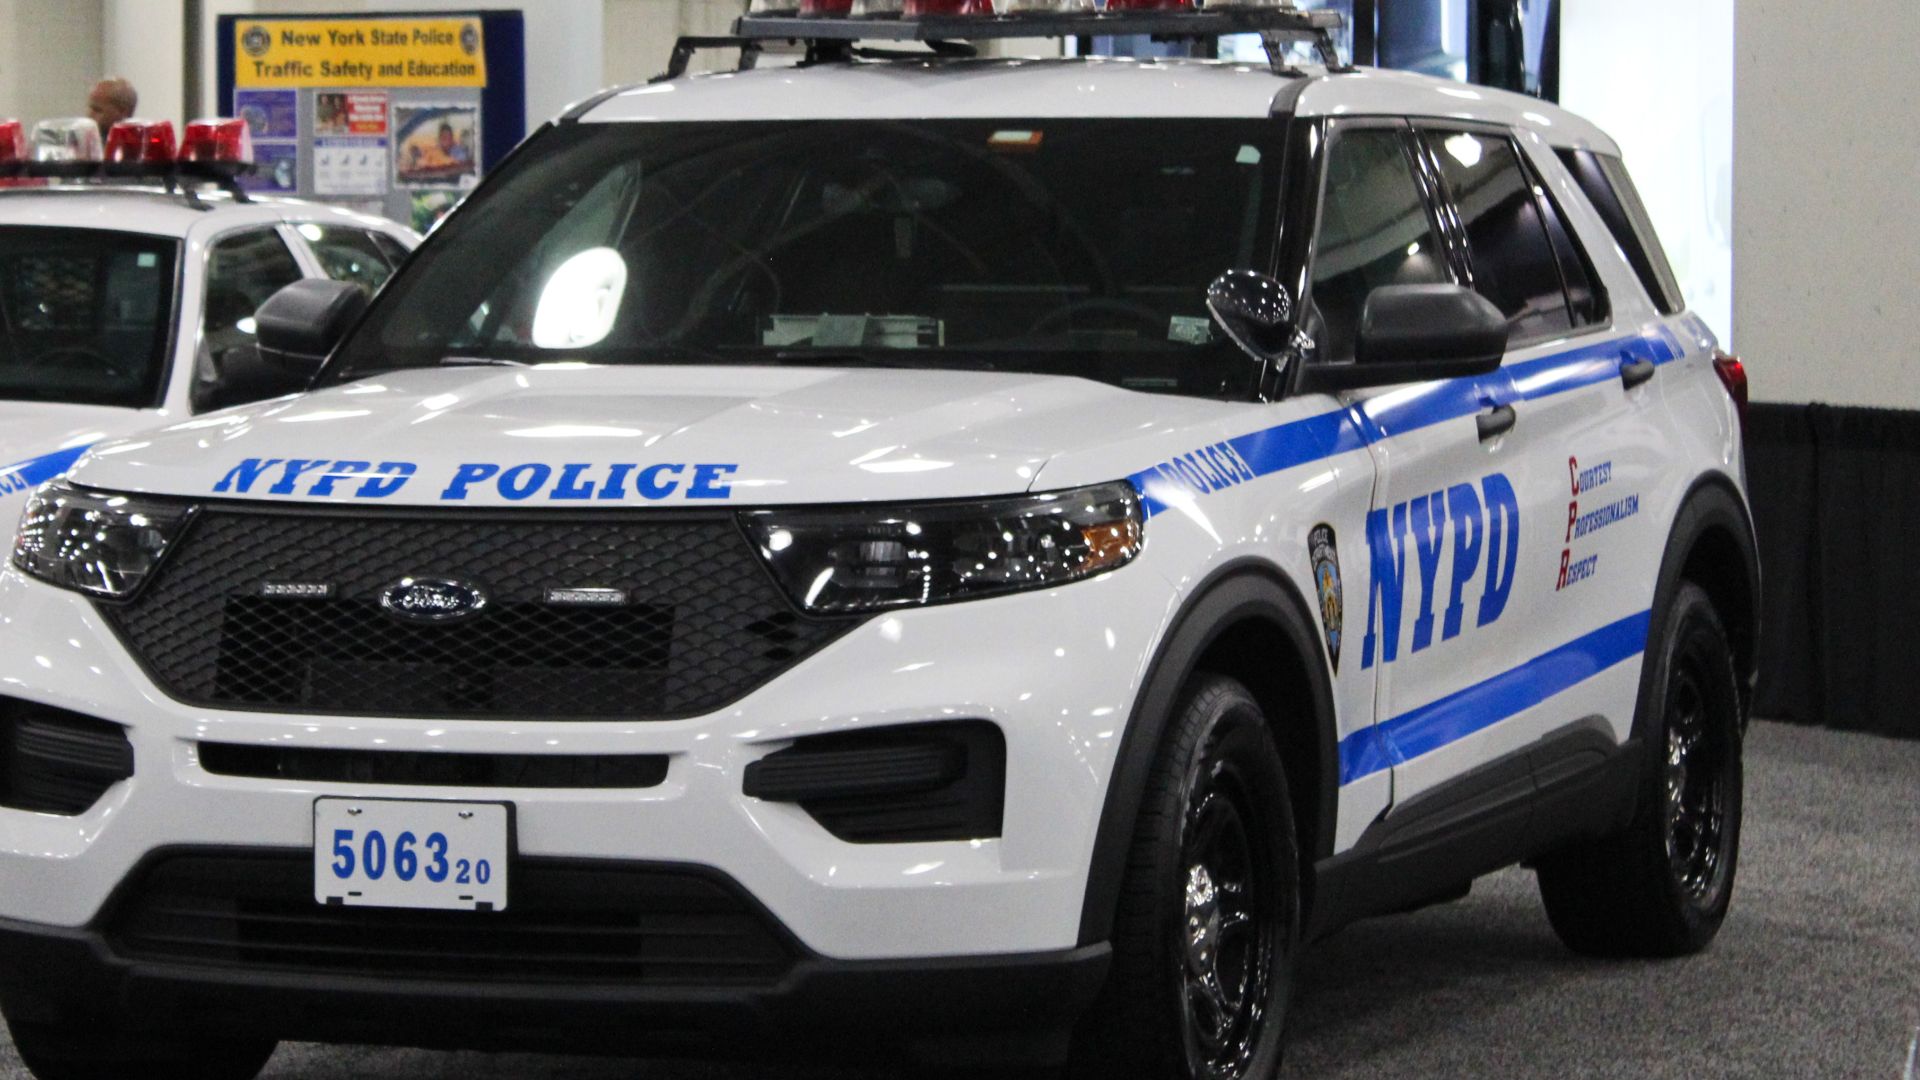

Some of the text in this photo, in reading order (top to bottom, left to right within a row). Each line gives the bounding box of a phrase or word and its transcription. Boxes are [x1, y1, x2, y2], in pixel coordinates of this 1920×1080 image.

[281, 27, 454, 48] New York State Police
[252, 59, 476, 81] Traffic Safety and Education
[213, 457, 738, 500] NYPD POLICE
[1157, 441, 1253, 494] POLICE
[1565, 493, 1639, 543] PROFESSIONALISM
[1361, 472, 1520, 671] NYPD
[1556, 548, 1598, 592] RESPECT
[332, 829, 490, 884] 5063 20
